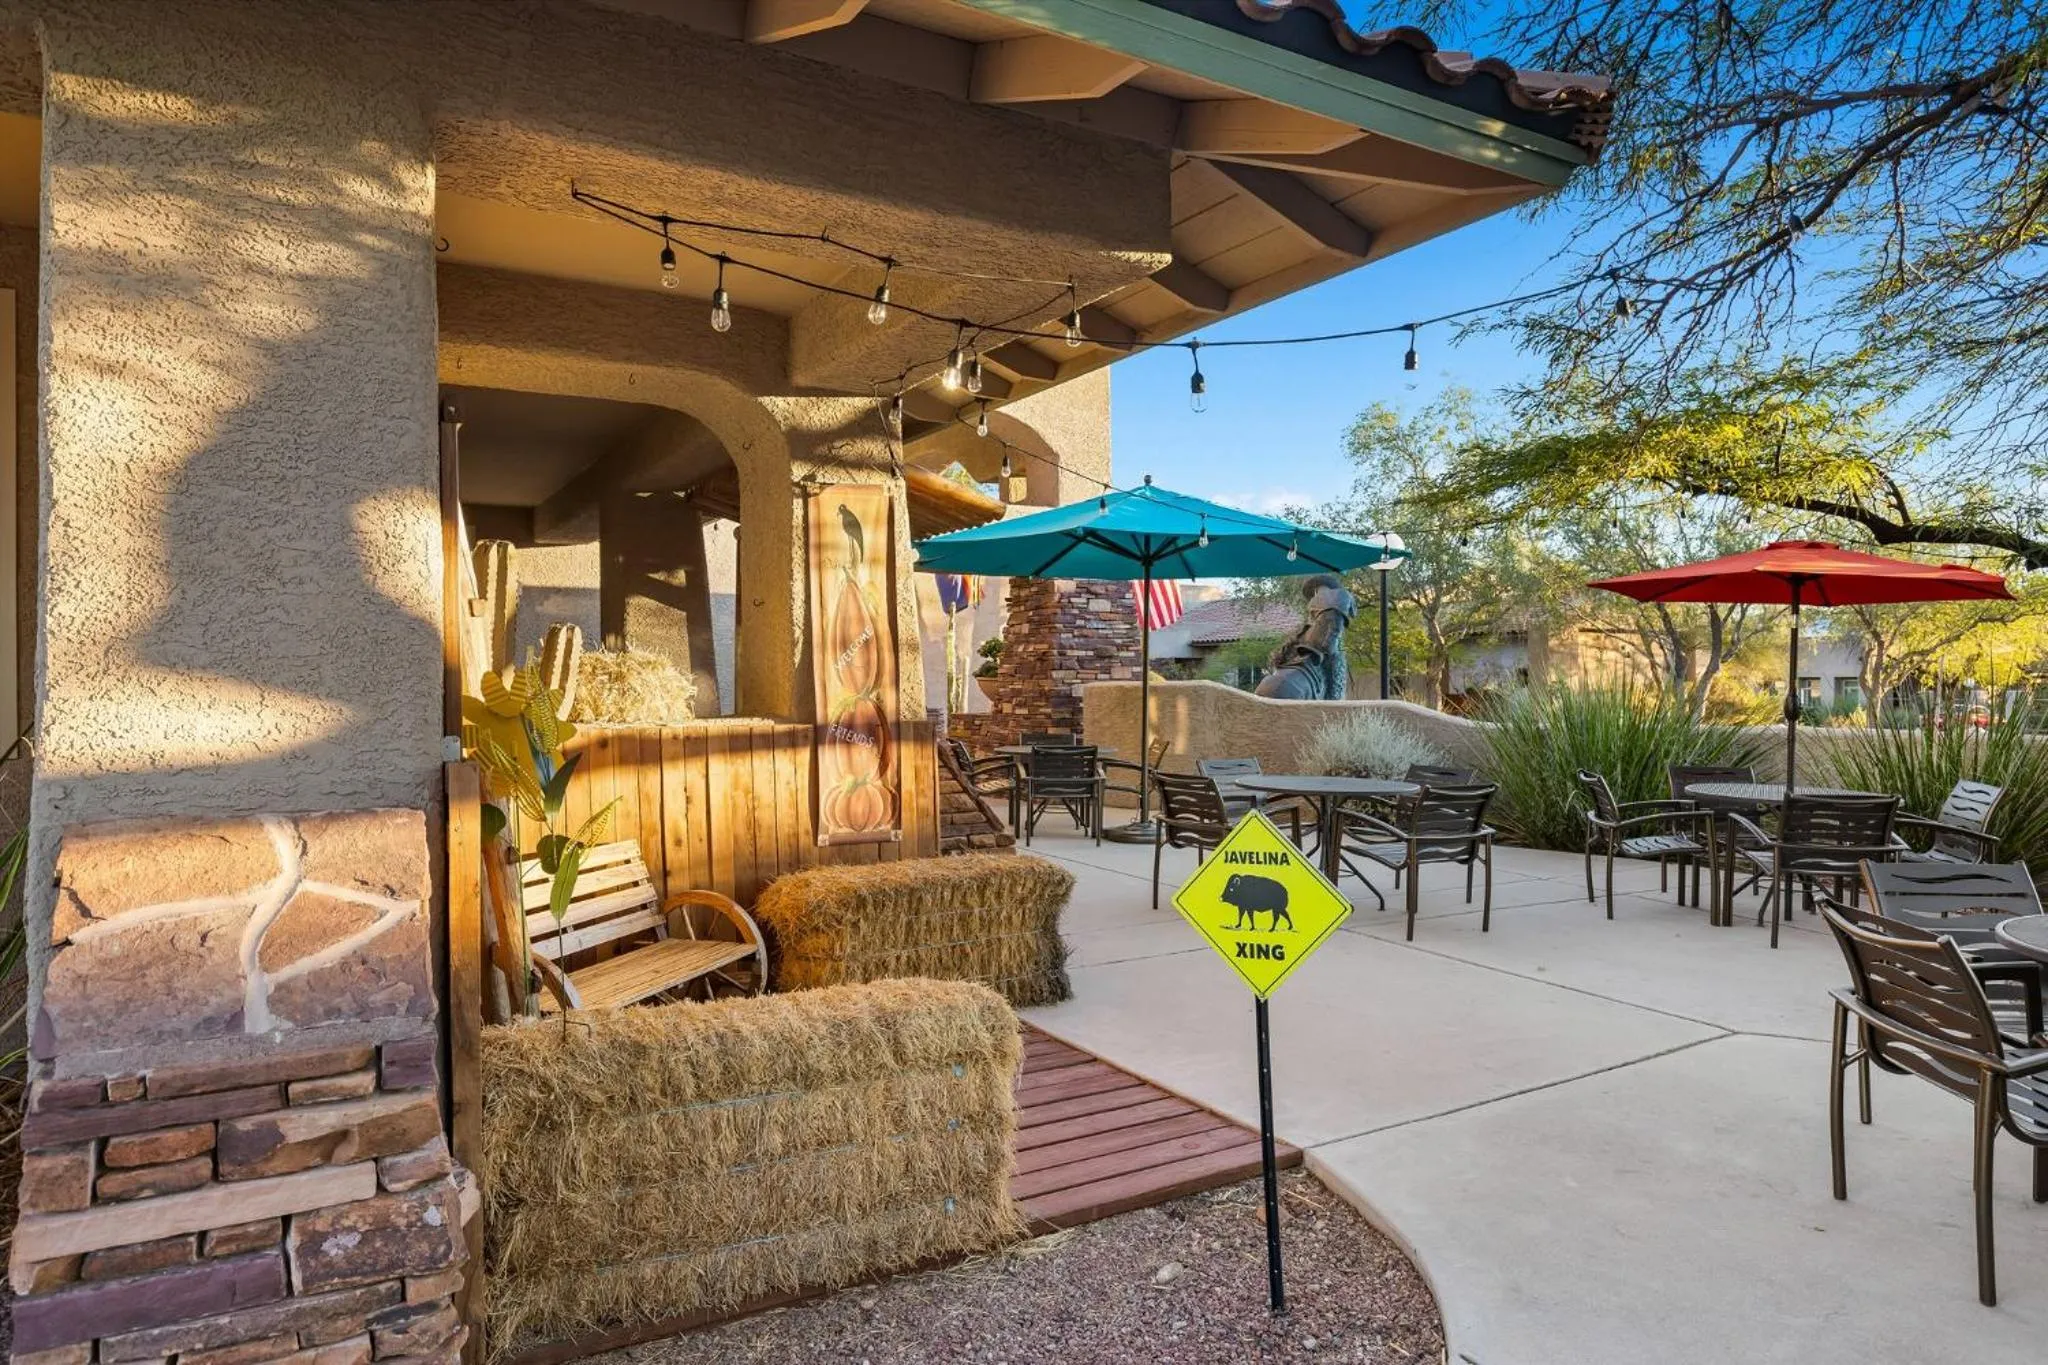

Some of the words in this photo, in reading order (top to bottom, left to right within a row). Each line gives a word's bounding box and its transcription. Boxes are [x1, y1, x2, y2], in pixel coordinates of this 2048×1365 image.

[832, 624, 874, 673] WELCOME
[829, 723, 874, 748] FRIENDS
[1224, 851, 1291, 866] JAVELINA
[1236, 942, 1286, 961] XING
